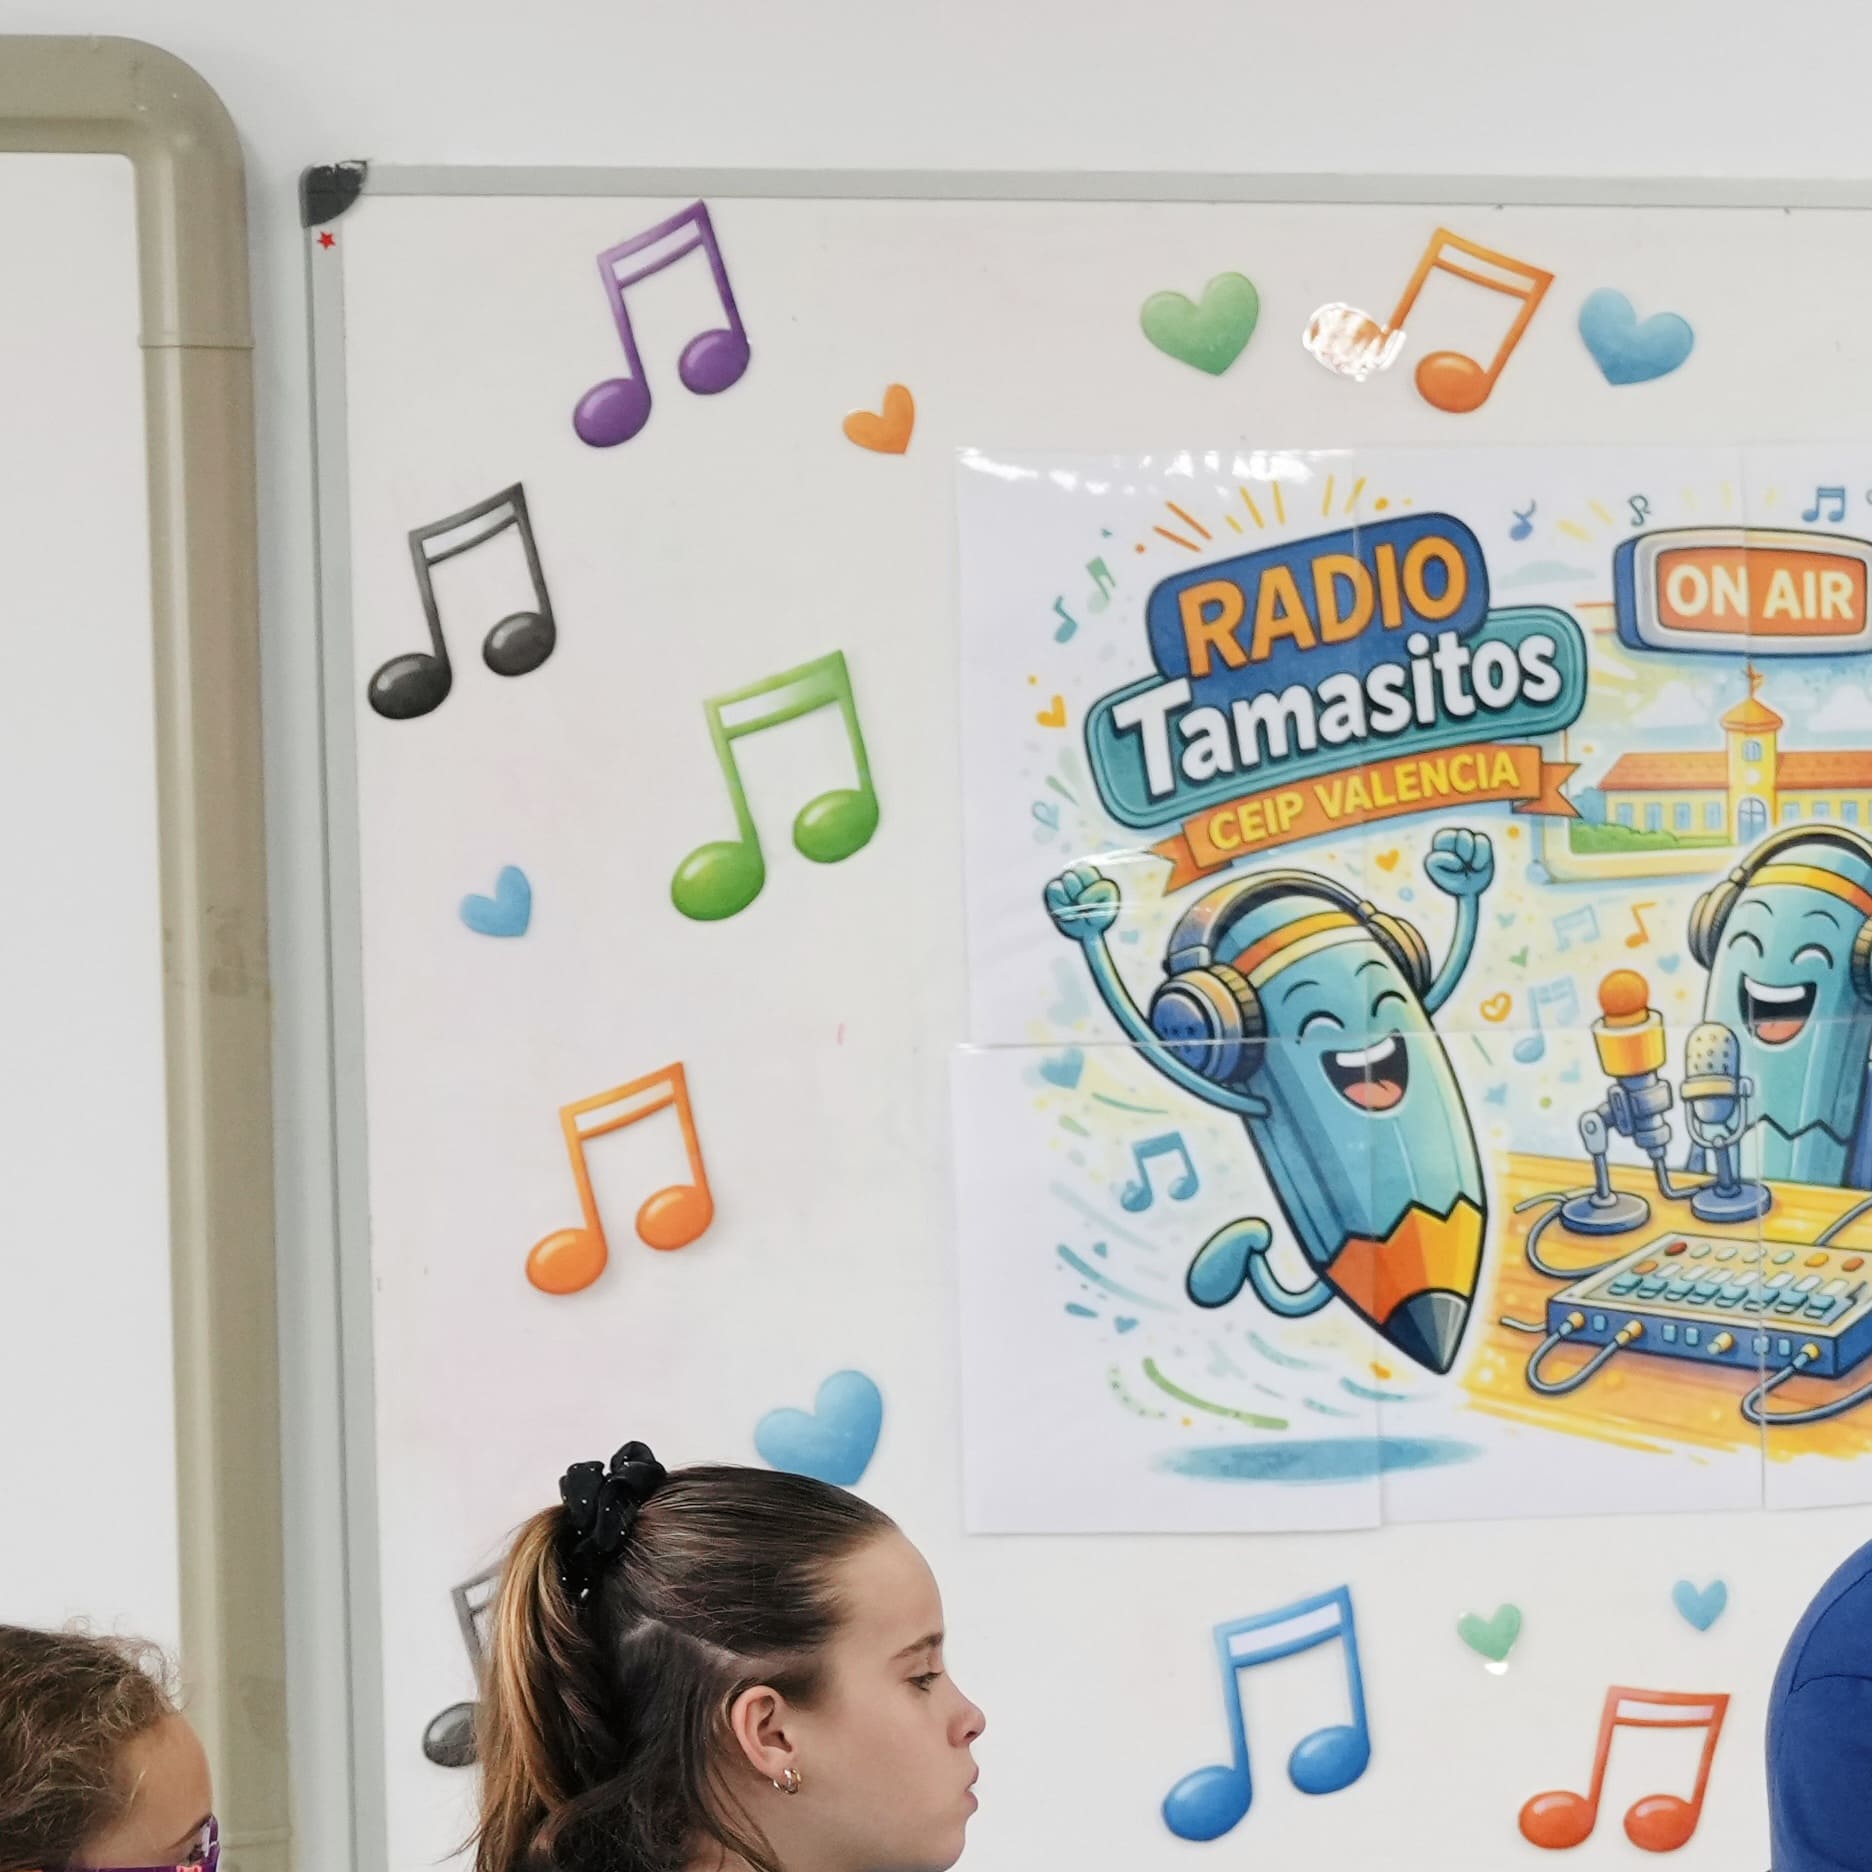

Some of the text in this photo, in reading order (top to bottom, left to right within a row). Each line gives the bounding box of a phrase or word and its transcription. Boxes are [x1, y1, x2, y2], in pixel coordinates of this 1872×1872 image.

[1177, 535, 1469, 678] RADIO
[1666, 564, 1855, 620] ON AIR
[1113, 631, 1562, 797] Tamasitos
[1208, 751, 1521, 851] CEIP VALENCIA
